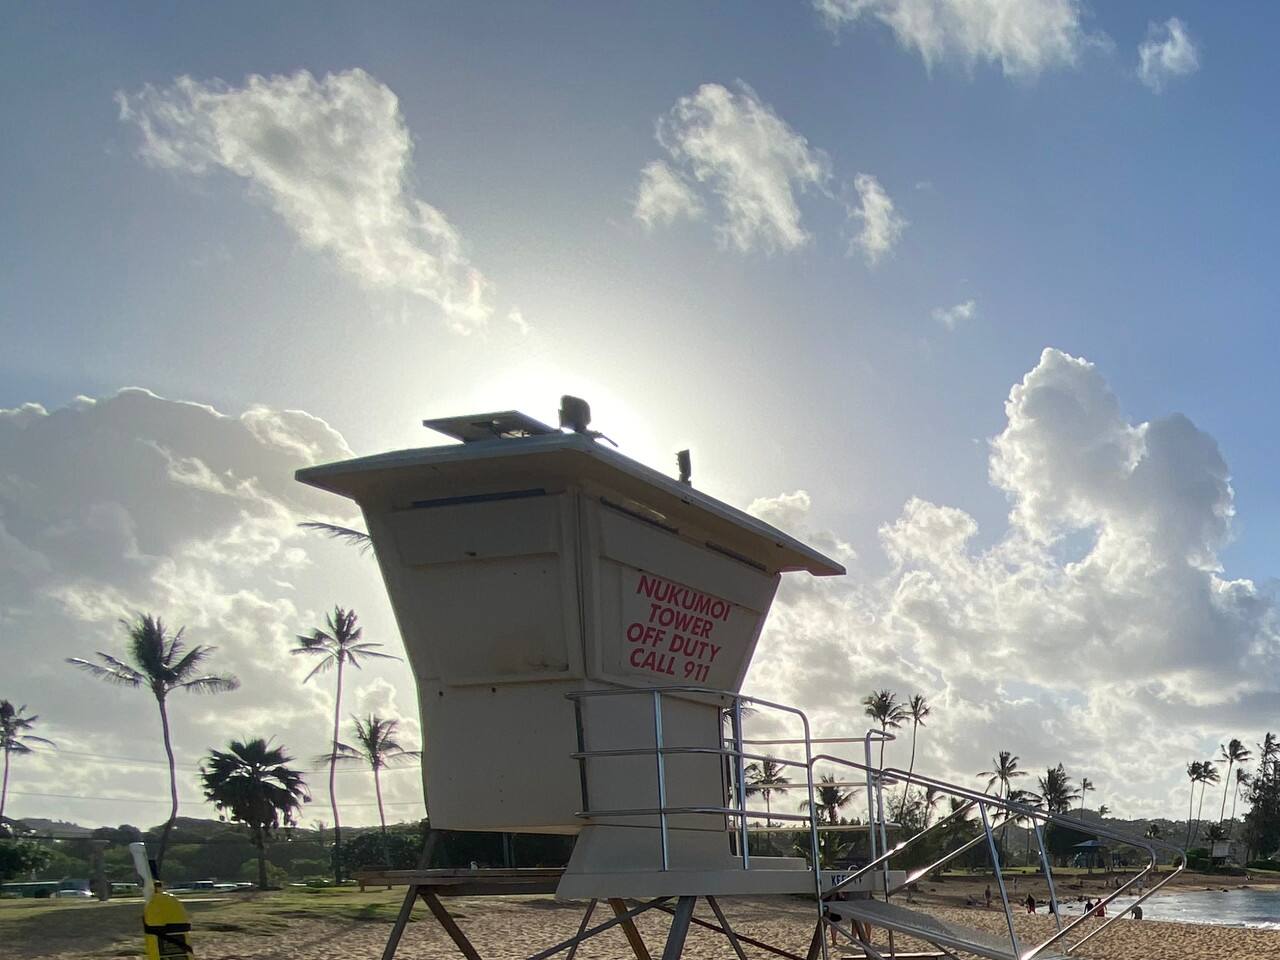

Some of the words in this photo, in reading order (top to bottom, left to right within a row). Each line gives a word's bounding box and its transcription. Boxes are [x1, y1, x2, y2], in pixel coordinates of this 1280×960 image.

[636, 575, 731, 621] NUKUMOI
[649, 603, 714, 639] TOWER
[626, 623, 666, 647] OFF
[669, 634, 722, 662] DUTY
[630, 648, 675, 675] CALL
[684, 661, 710, 682] 911
